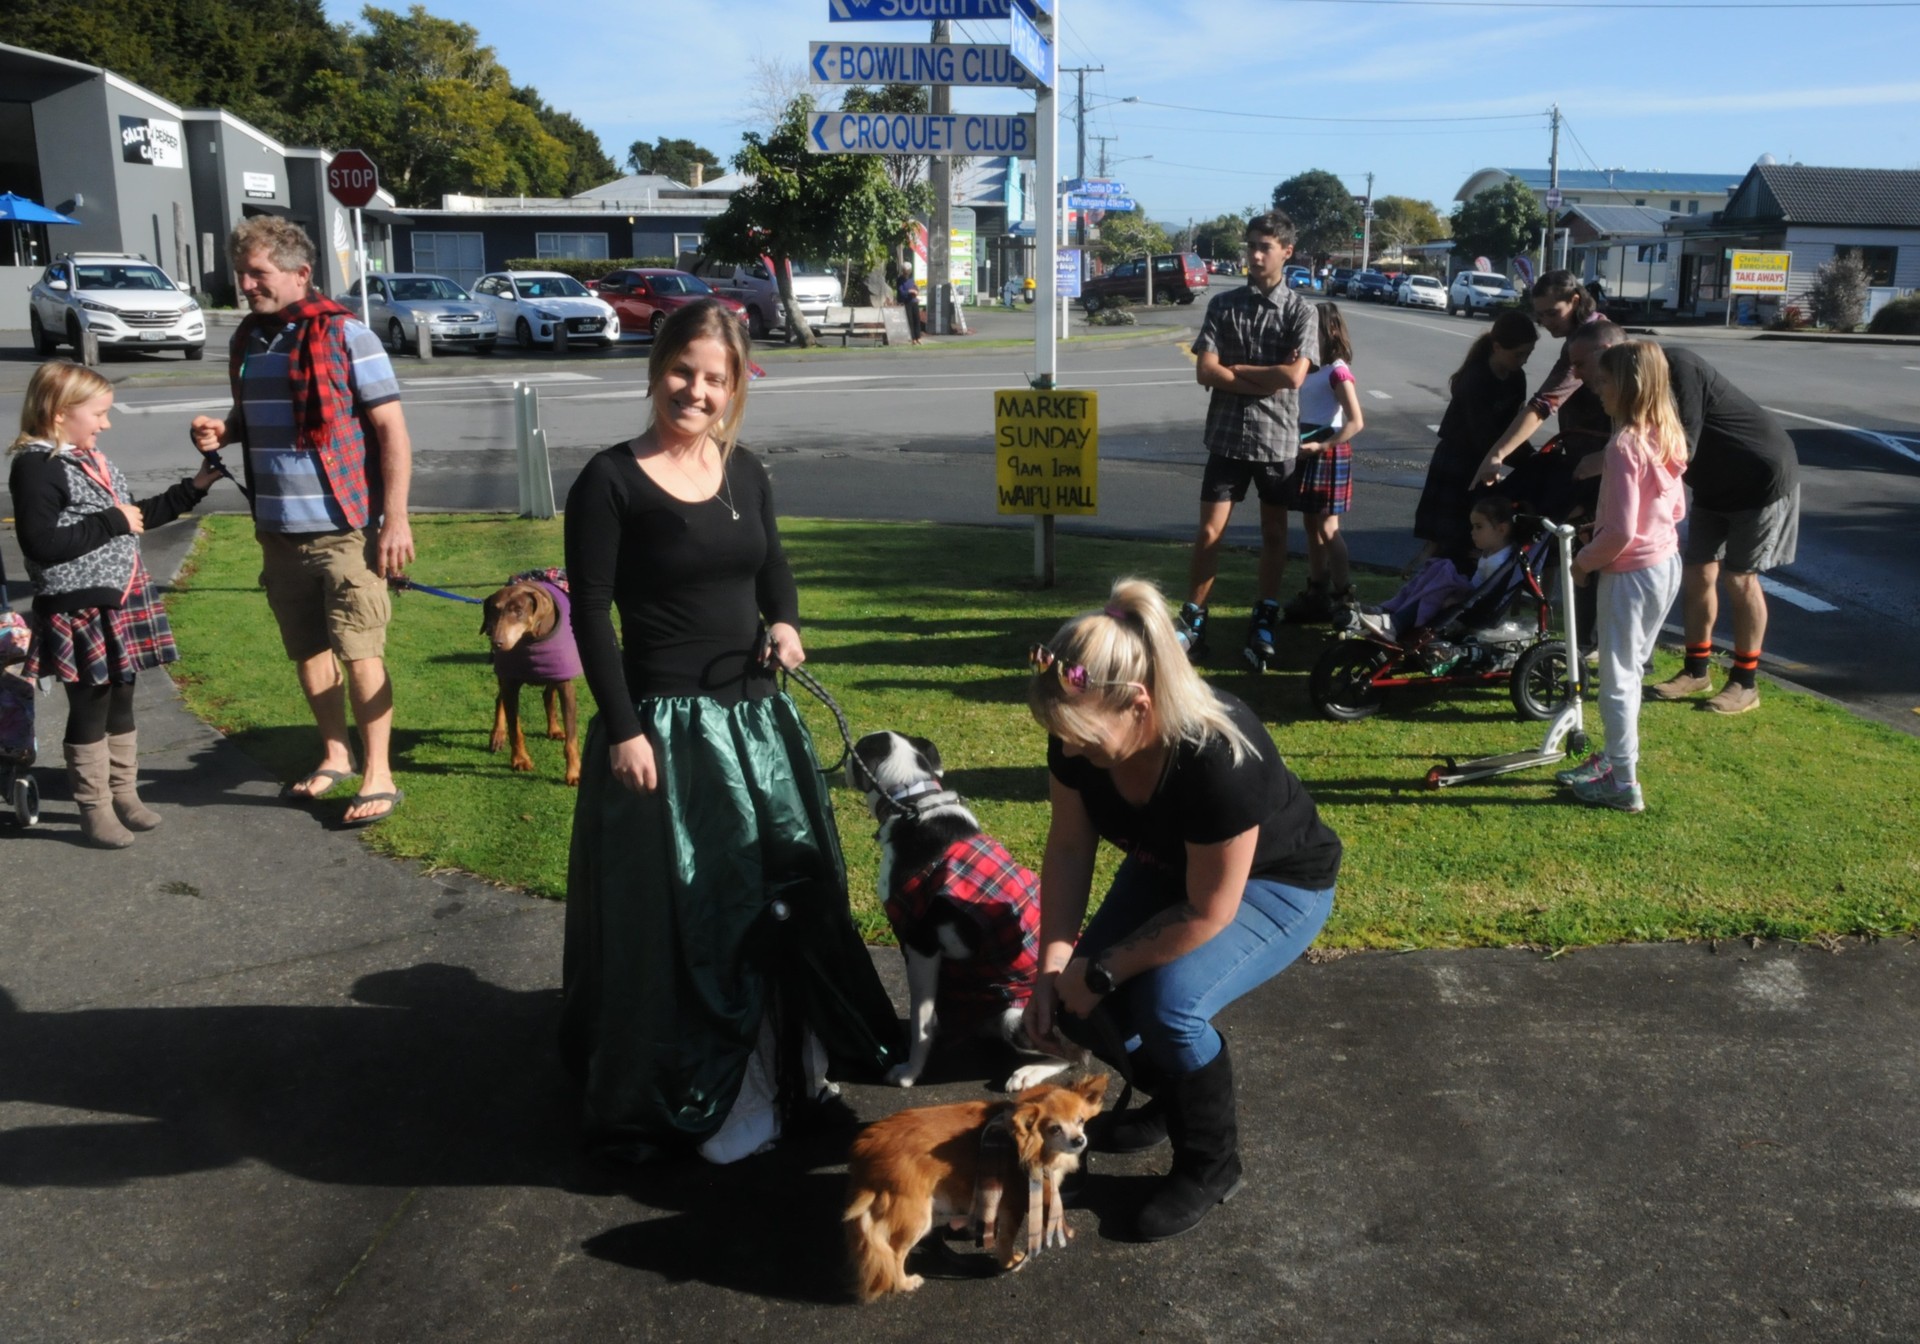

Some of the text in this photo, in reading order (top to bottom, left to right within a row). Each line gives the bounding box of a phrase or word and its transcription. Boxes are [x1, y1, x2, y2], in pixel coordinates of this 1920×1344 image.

[839, 46, 1027, 83] BOWLING CLUB
[839, 115, 1027, 151] CROQUET CLUB
[140, 145, 164, 160] CAFE
[330, 169, 374, 189] STOP
[1072, 196, 1106, 209] Whangarei
[1736, 272, 1784, 283] TAKE AWAYS
[997, 396, 1089, 420] MARKET
[999, 425, 1092, 450] SUNDAY
[998, 484, 1095, 510] WAIPU HALL
